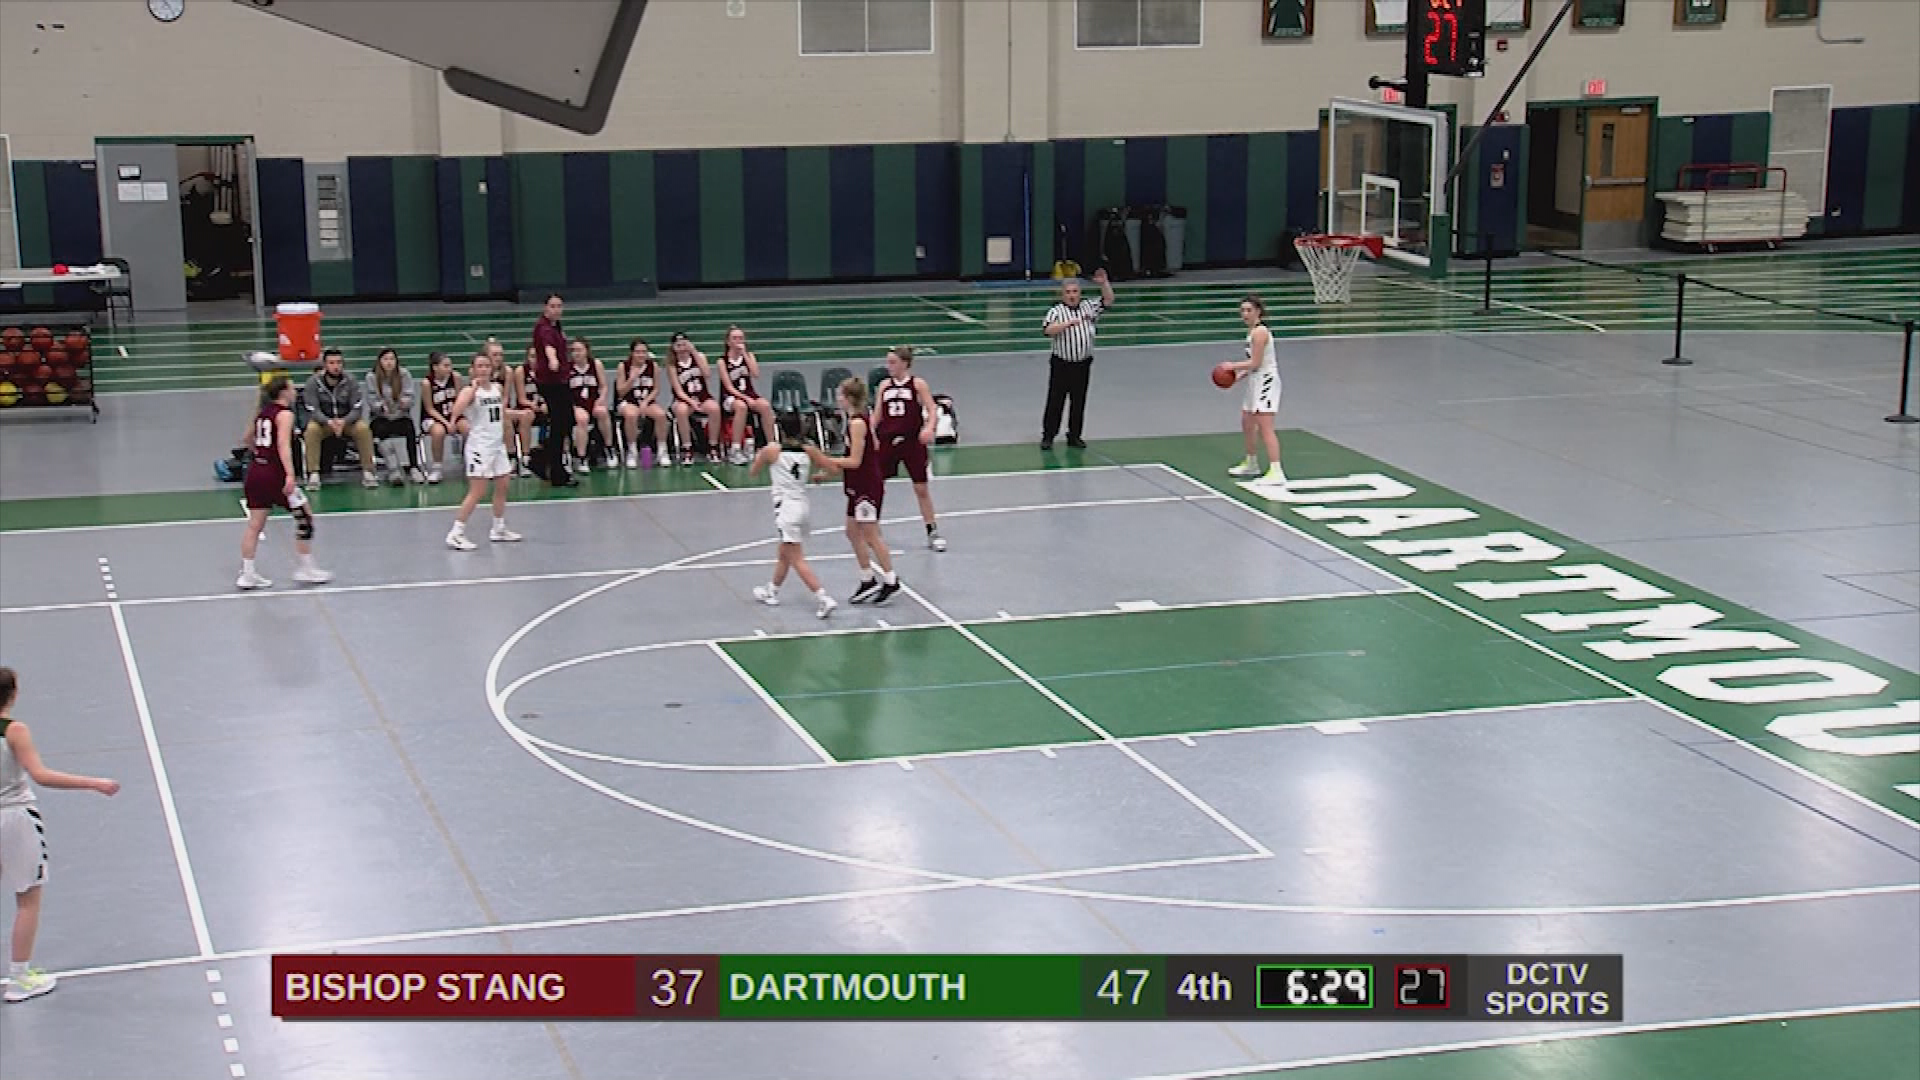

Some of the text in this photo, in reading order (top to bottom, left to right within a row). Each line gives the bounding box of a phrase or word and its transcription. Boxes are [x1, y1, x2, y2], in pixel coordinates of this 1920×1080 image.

[1424, 11, 1458, 65] 27
[888, 401, 906, 417] 23
[255, 417, 273, 447] 13
[790, 461, 800, 480] 4
[1235, 473, 1920, 800] DARTMOU
